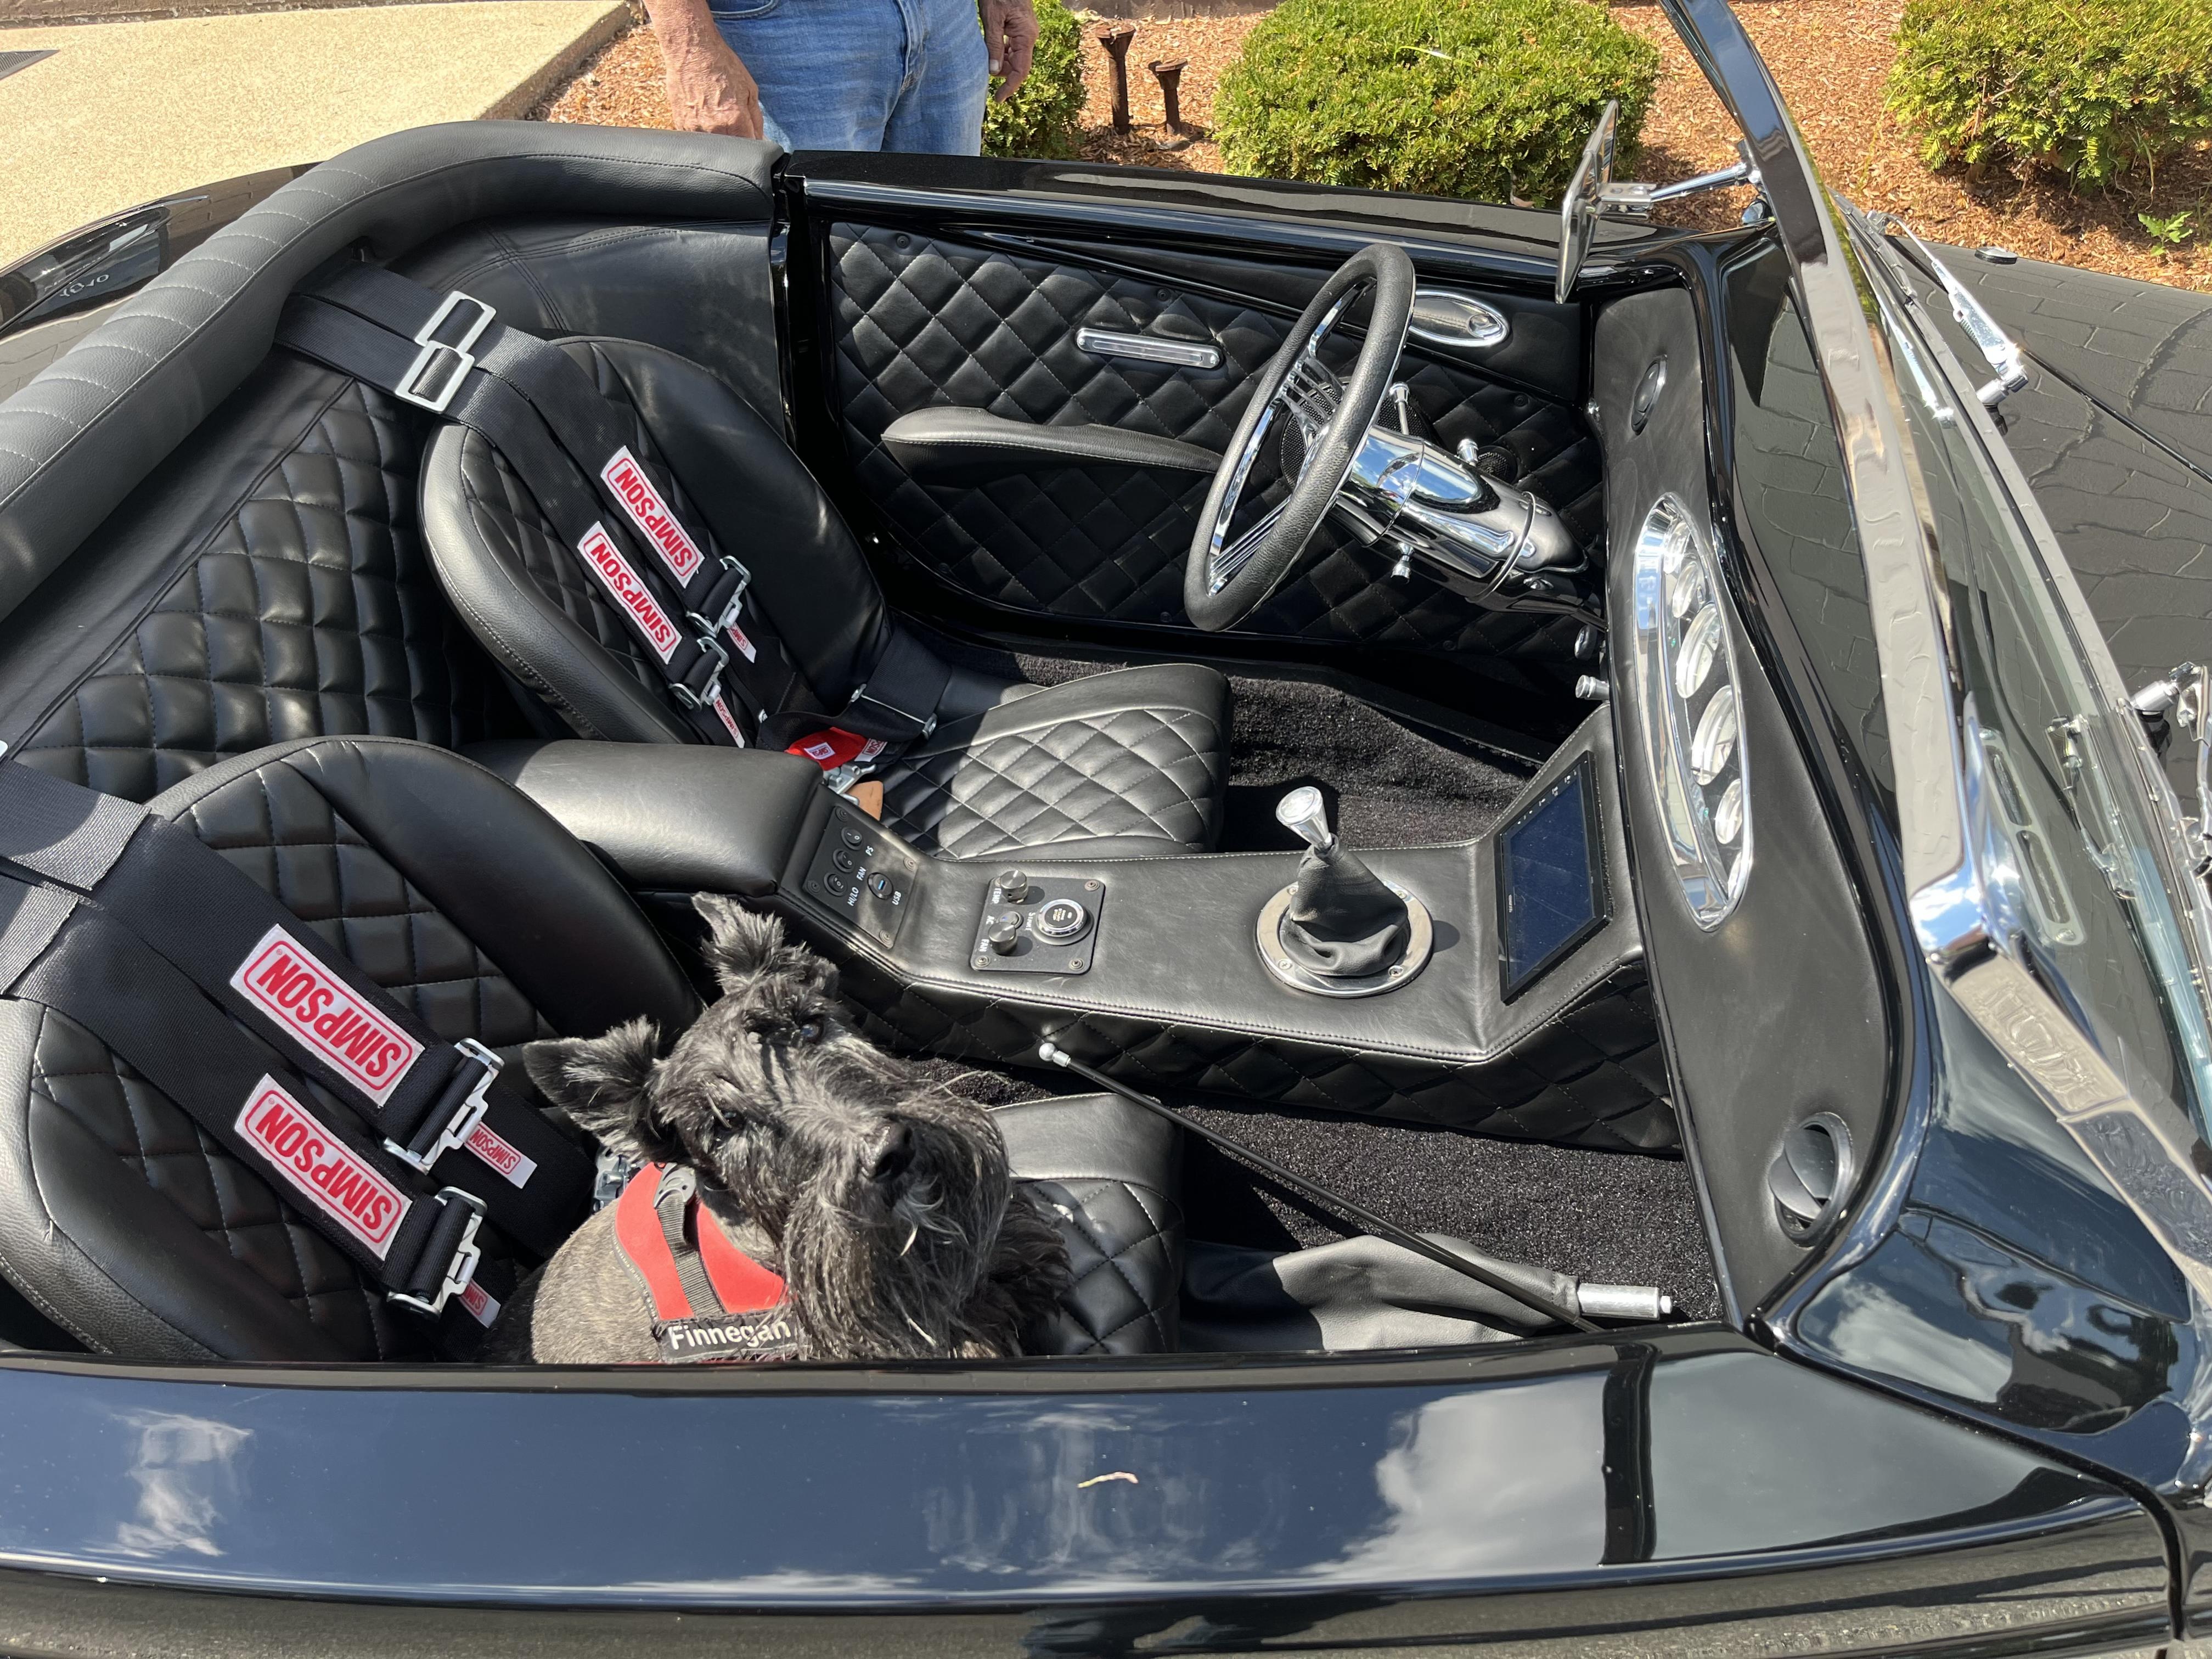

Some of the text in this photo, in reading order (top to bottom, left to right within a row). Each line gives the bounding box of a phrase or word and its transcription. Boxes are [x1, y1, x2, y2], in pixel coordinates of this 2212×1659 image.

[615, 467, 693, 569] SIMPSON
[590, 541, 671, 644] SIMPSON
[729, 625, 747, 648] SIMP
[716, 699, 738, 735] SIMPSON
[865, 846, 874, 856] PS
[856, 867, 866, 881] FAN
[847, 887, 859, 906] HI/LO
[892, 891, 902, 905] USB
[992, 888, 1001, 904] TEMP
[986, 915, 995, 925] AC
[1025, 912, 1036, 931] START
[979, 938, 989, 952] FAN
[256, 953, 403, 1079] SIMPSON
[470, 1128, 516, 1170] SIMPSON
[255, 1103, 392, 1230] SIMPSON
[667, 1320, 791, 1351] Finnegan
